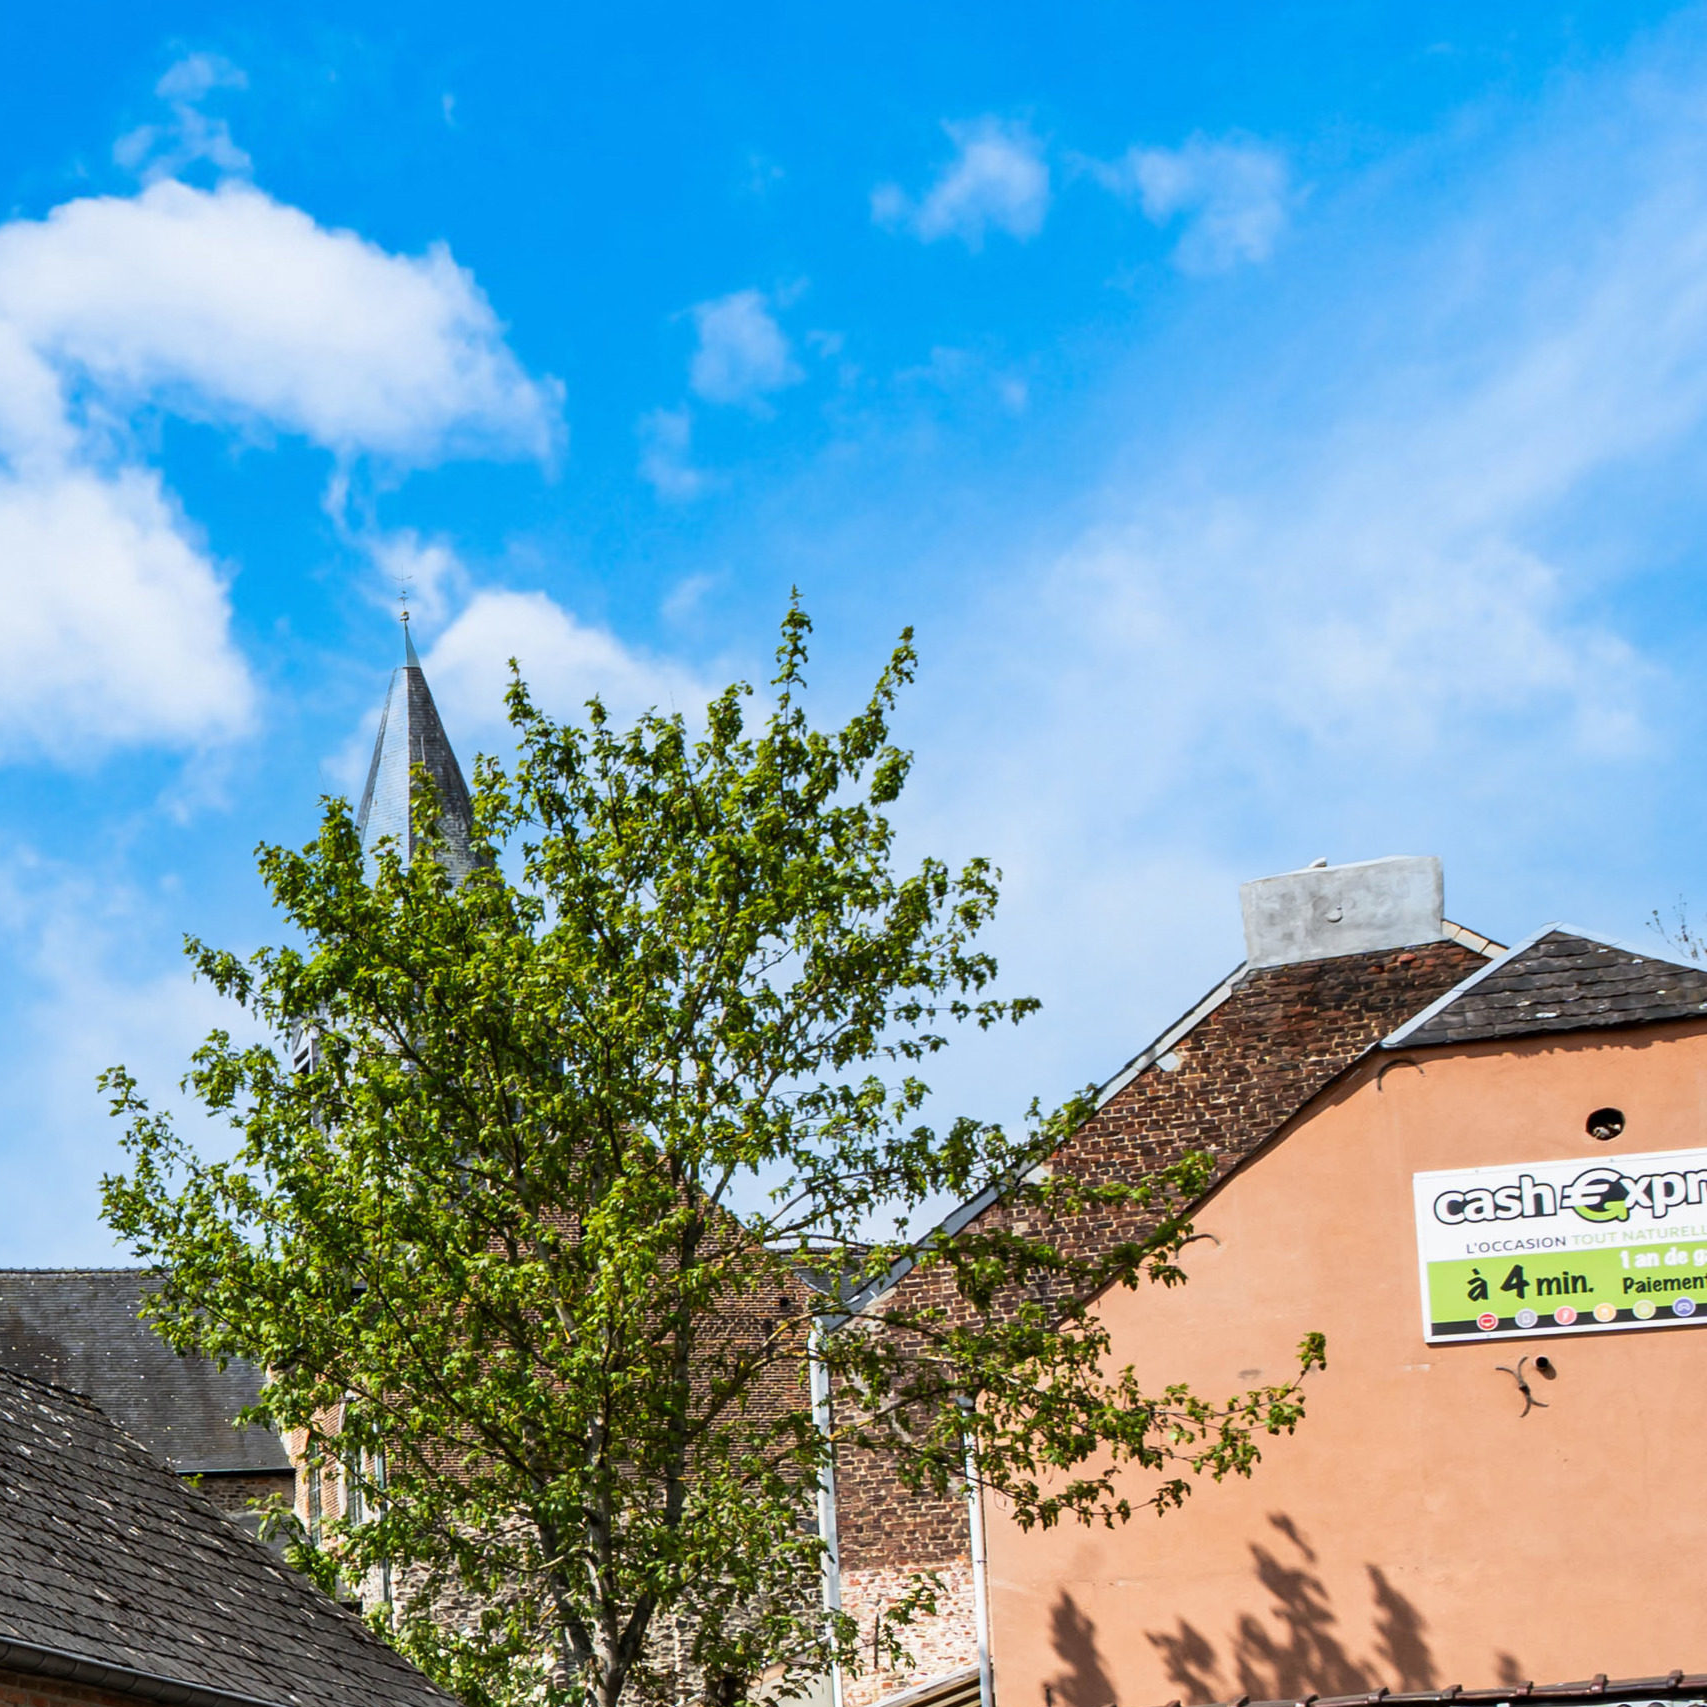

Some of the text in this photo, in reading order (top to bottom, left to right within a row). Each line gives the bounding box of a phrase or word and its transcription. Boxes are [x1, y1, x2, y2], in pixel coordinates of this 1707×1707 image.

[1434, 1174, 1557, 1225] cash
[1465, 1236, 1567, 1255] L'OCCASION
[1571, 1231, 1617, 1246] TOUT
[1620, 1246, 1707, 1269] 1 an de g
[1467, 1264, 1594, 1302] à 4 min.
